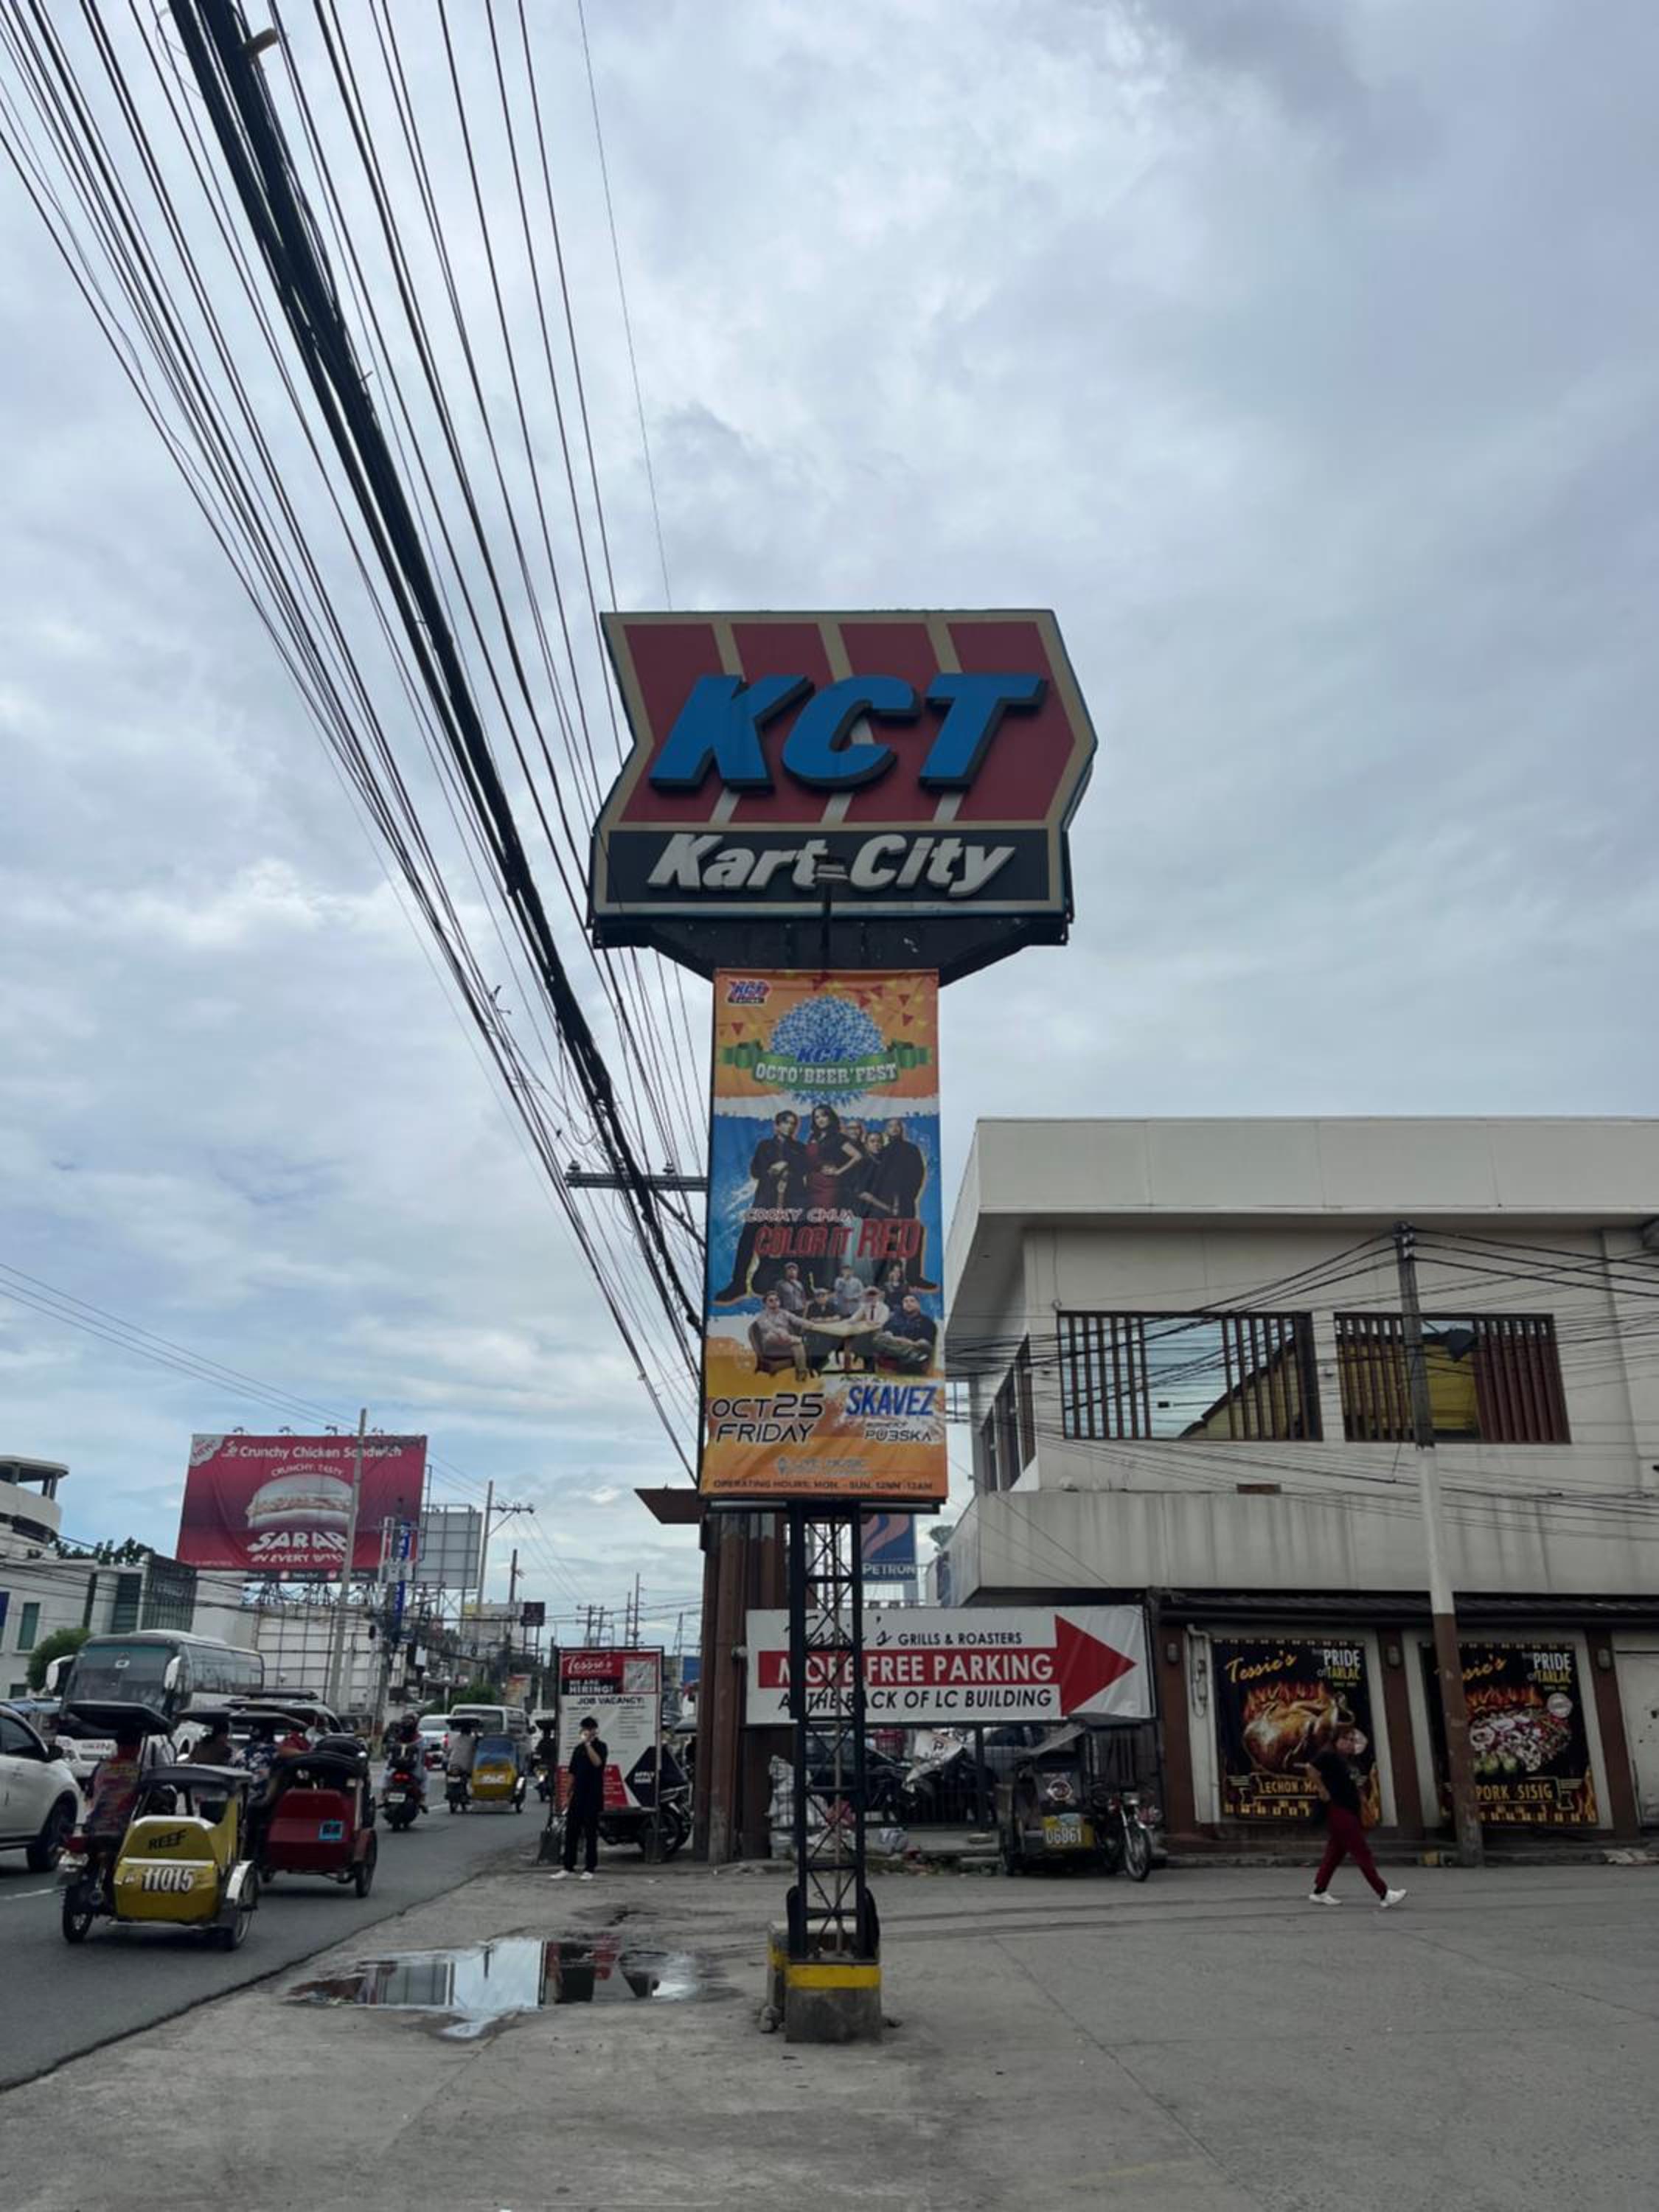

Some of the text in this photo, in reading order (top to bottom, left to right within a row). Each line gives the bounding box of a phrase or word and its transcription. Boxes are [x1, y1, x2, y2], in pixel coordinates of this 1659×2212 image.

[649, 674, 1048, 791] KCT
[647, 834, 1015, 897] Kart City
[754, 1226, 829, 1256] COLOR
[858, 1218, 922, 1259] RED
[846, 1386, 937, 1416] SKAVEZ
[716, 1424, 815, 1443] FRIDAY
[240, 1445, 289, 1460] Crunchy
[293, 1445, 339, 1458] Chicken
[713, 1479, 771, 1488] OPERATING
[862, 1562, 916, 1575] PETRON
[898, 1632, 941, 1645] GRILLS
[945, 1633, 953, 1645] &
[958, 1632, 1023, 1644] ROASTERS
[1224, 1649, 1297, 1683] Tessie's
[1324, 1649, 1361, 1668] PRIDE
[1533, 1652, 1572, 1671] PRIDE
[866, 1654, 925, 1683] FREE
[933, 1654, 1054, 1682] PARKING
[568, 1685, 614, 1694] HIRING!
[807, 1692, 838, 1710] THE
[904, 1690, 930, 1708] OF
[935, 1690, 959, 1708] LC
[964, 1688, 1052, 1708] BUILDING
[577, 1697, 596, 1705] JOB
[1259, 1781, 1299, 1795] LECHON
[1475, 1784, 1554, 1801] PORK SISIG
[142, 1866, 195, 1895] 11015
